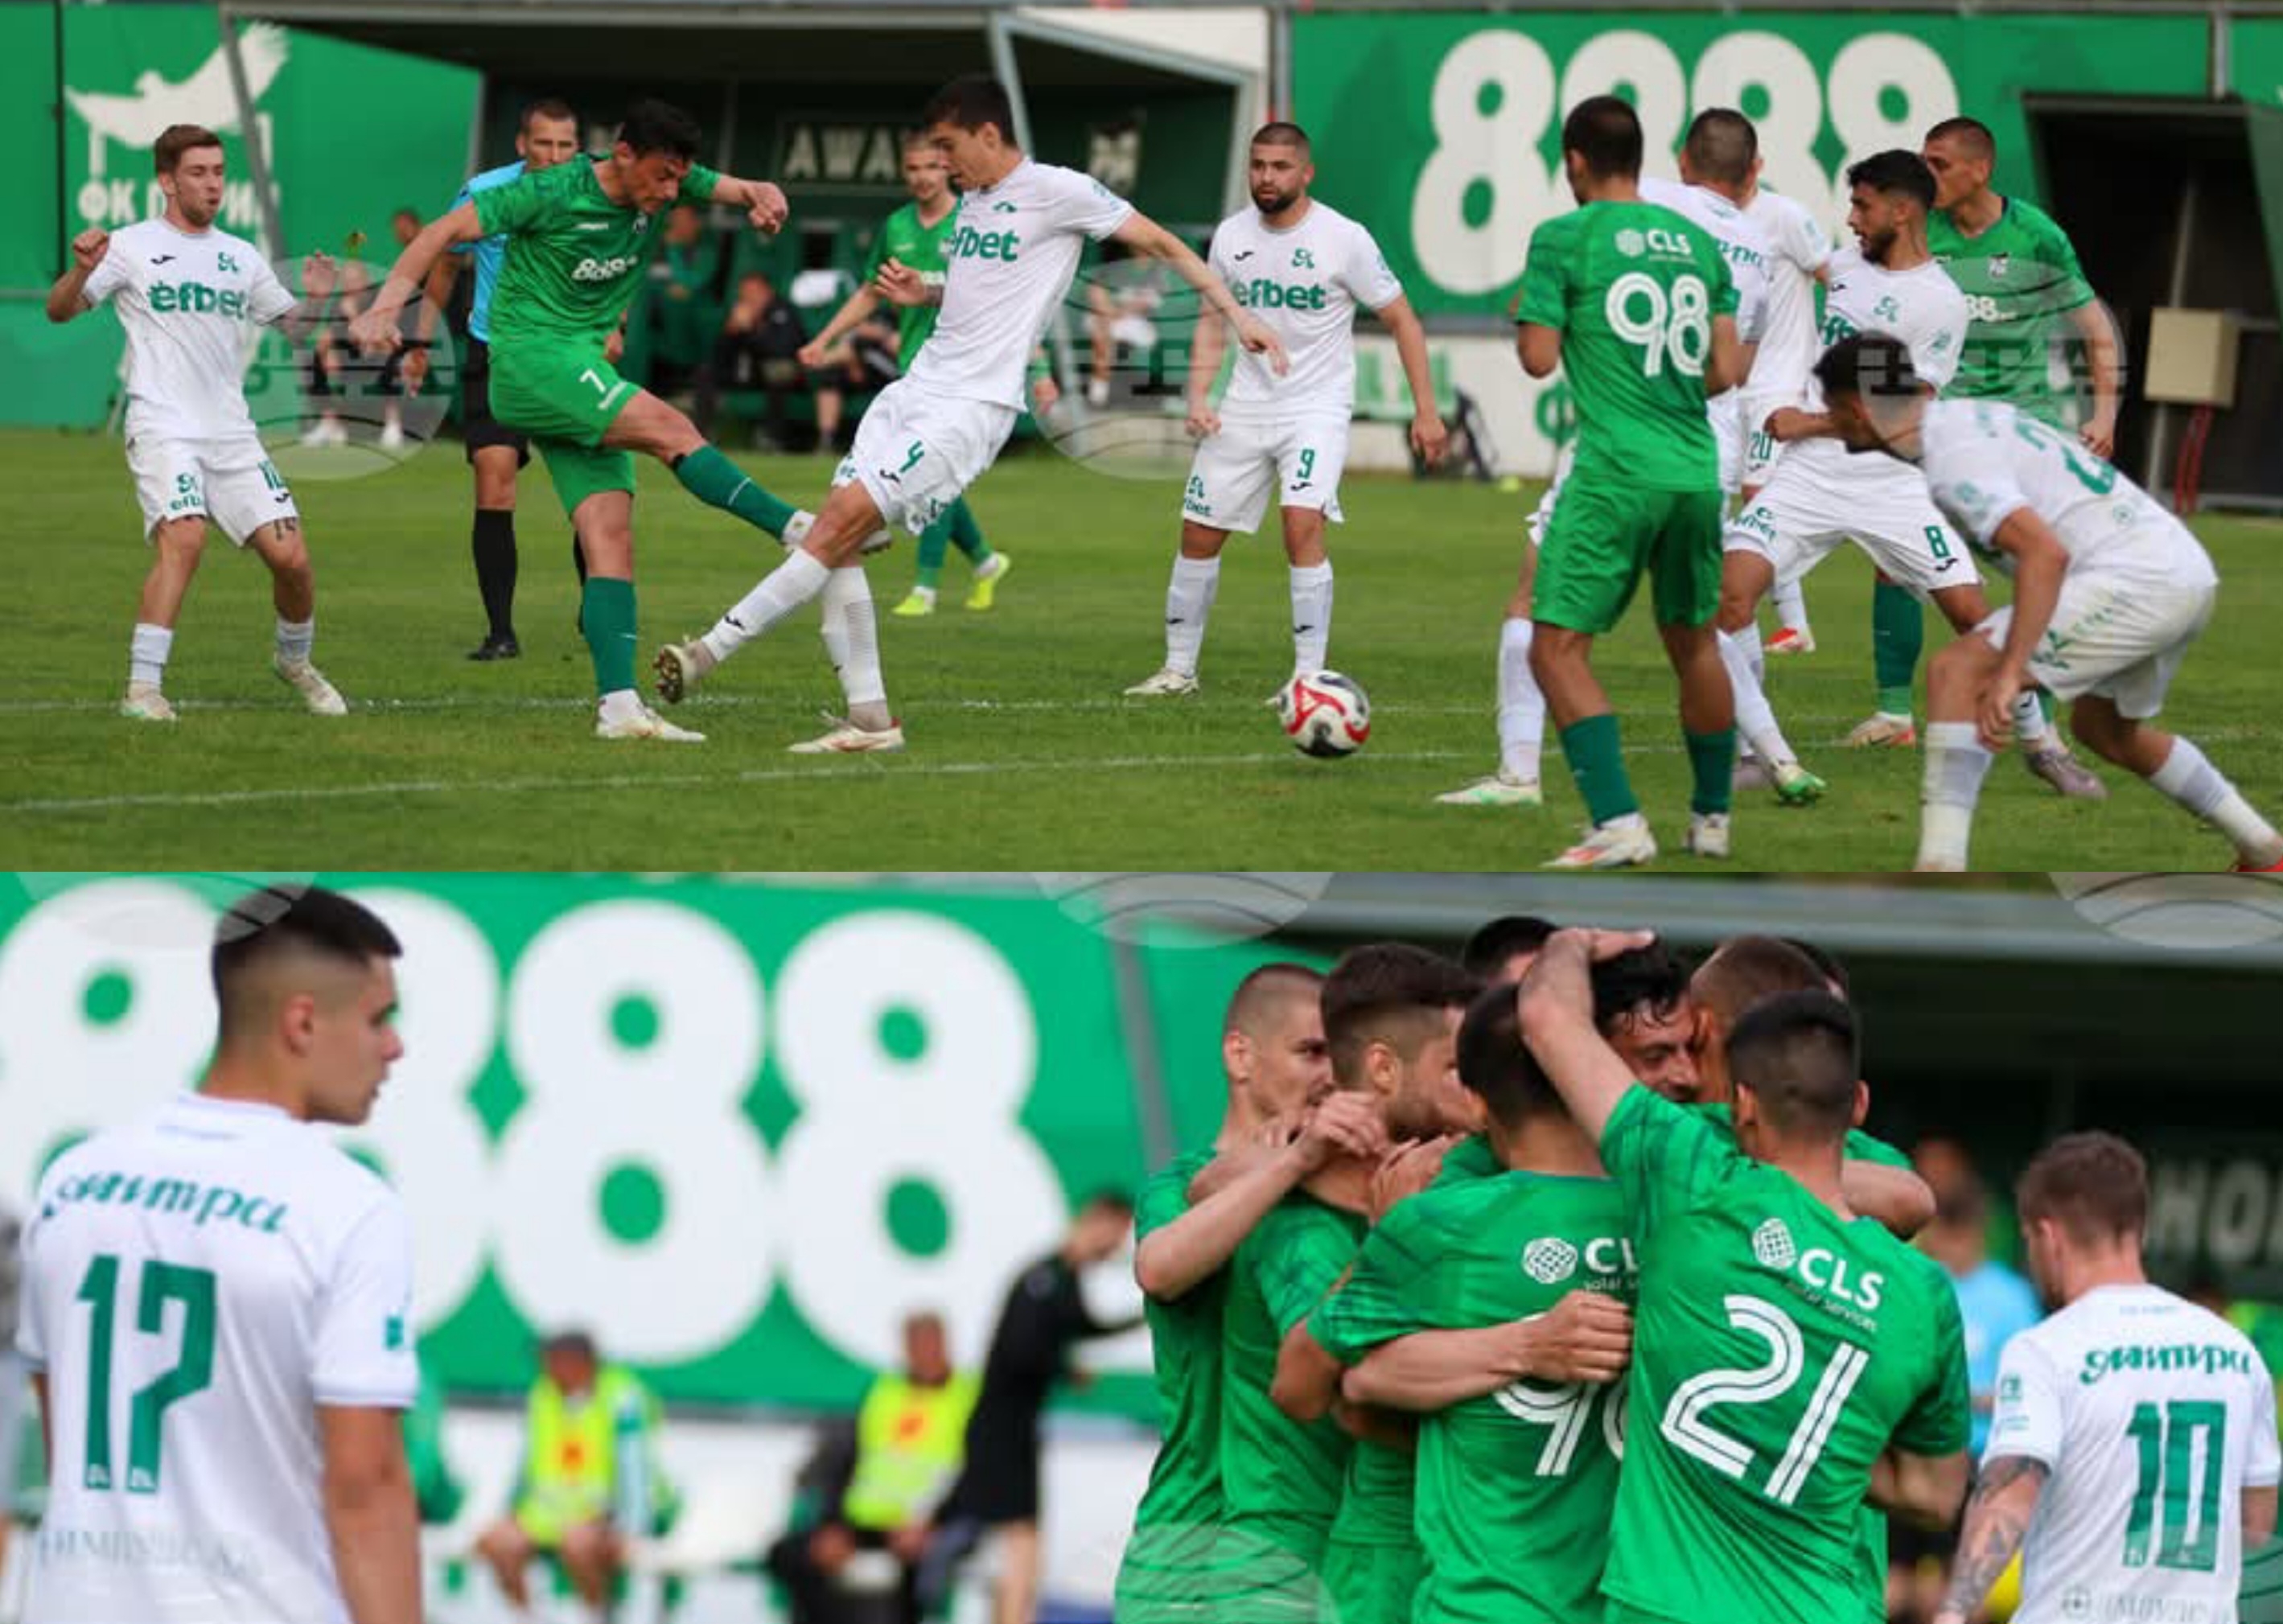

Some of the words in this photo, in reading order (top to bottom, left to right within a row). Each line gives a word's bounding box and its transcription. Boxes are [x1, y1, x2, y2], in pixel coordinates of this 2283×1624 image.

[784, 126, 909, 179] AWA
[948, 226, 1020, 262] fbet
[1647, 228, 1692, 255] CLS
[1232, 278, 1326, 310] efbet
[1606, 272, 1710, 378] 98
[579, 368, 607, 394] 7
[899, 441, 924, 473] 4
[1298, 448, 1315, 479] 9
[1924, 524, 1950, 559] 8
[2146, 1158, 2283, 1263] HO
[1585, 1237, 1639, 1273] CL
[1799, 1248, 1885, 1312] CLS
[1660, 1293, 1870, 1505] 21
[2122, 1400, 2227, 1572] 10
